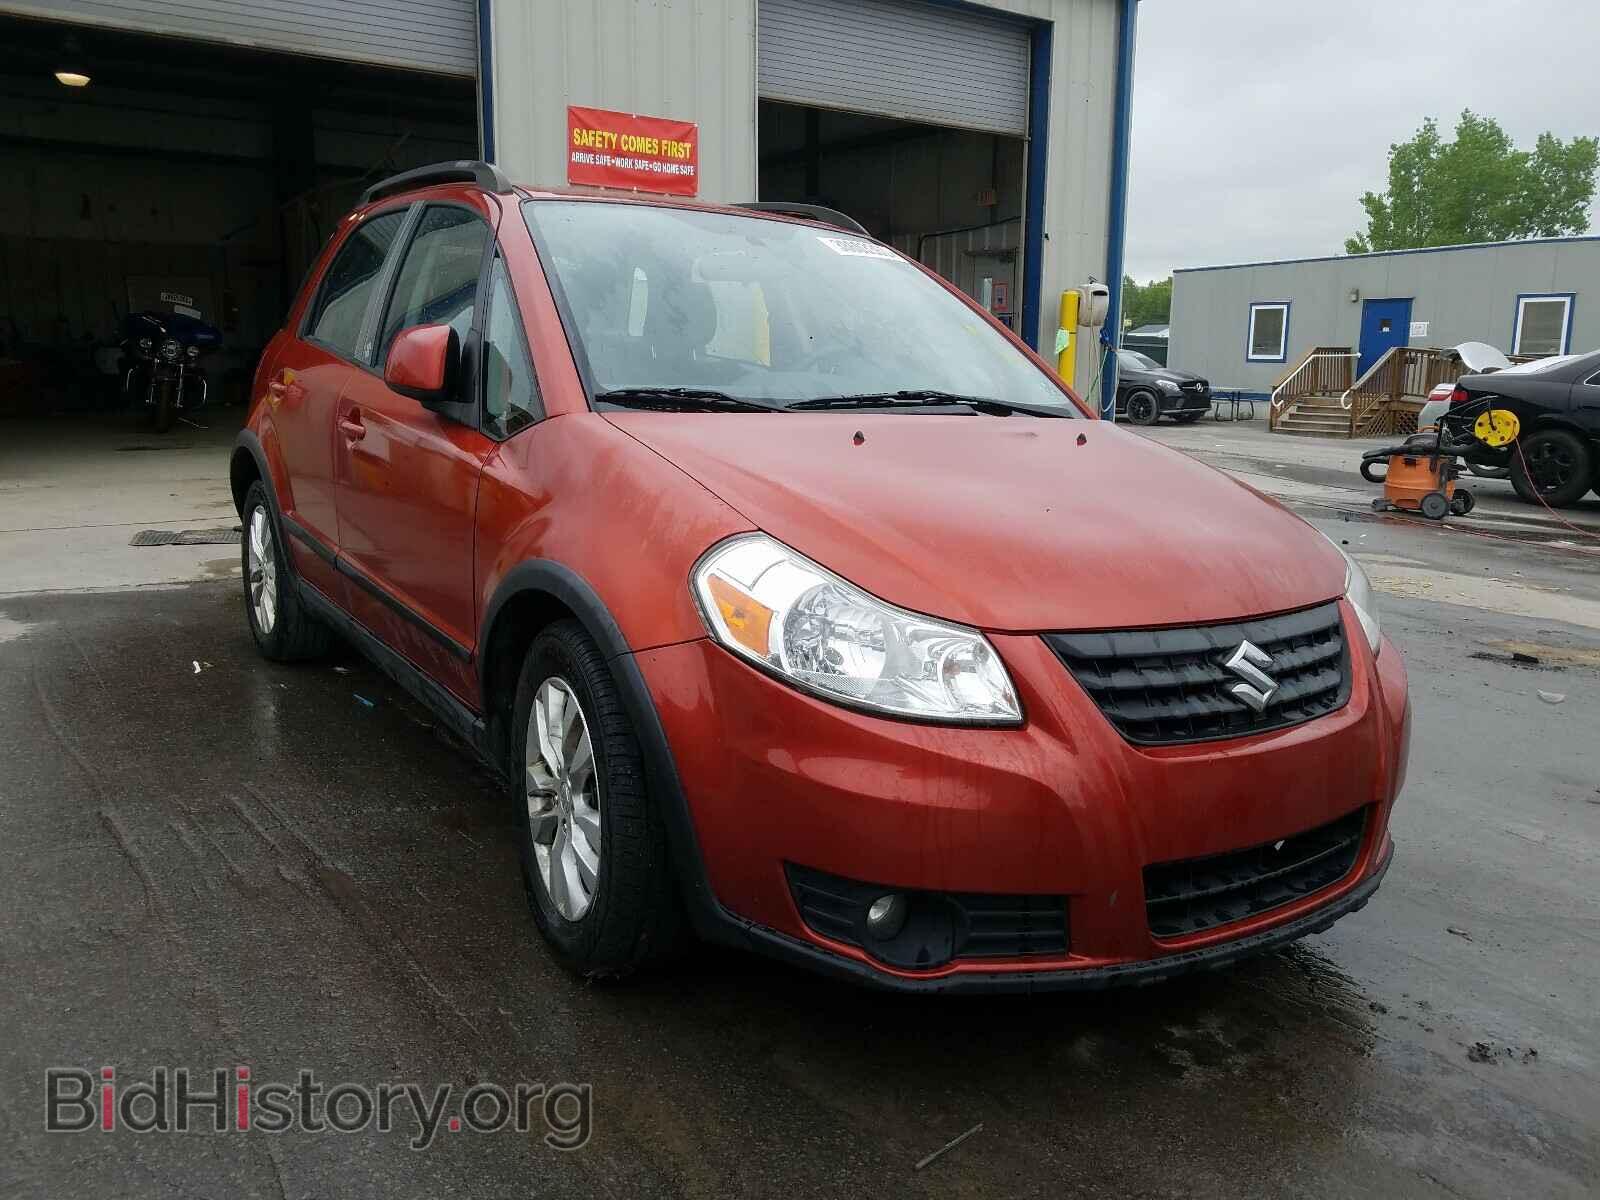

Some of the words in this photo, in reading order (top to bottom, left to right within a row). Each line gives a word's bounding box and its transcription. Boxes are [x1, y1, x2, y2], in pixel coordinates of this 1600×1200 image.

[573, 127, 618, 150] SAFETY
[621, 134, 659, 156] COMES
[661, 139, 692, 160] FIRST
[571, 151, 595, 165] ARRIVE
[662, 163, 680, 175] HOME
[680, 165, 695, 176] SAFE
